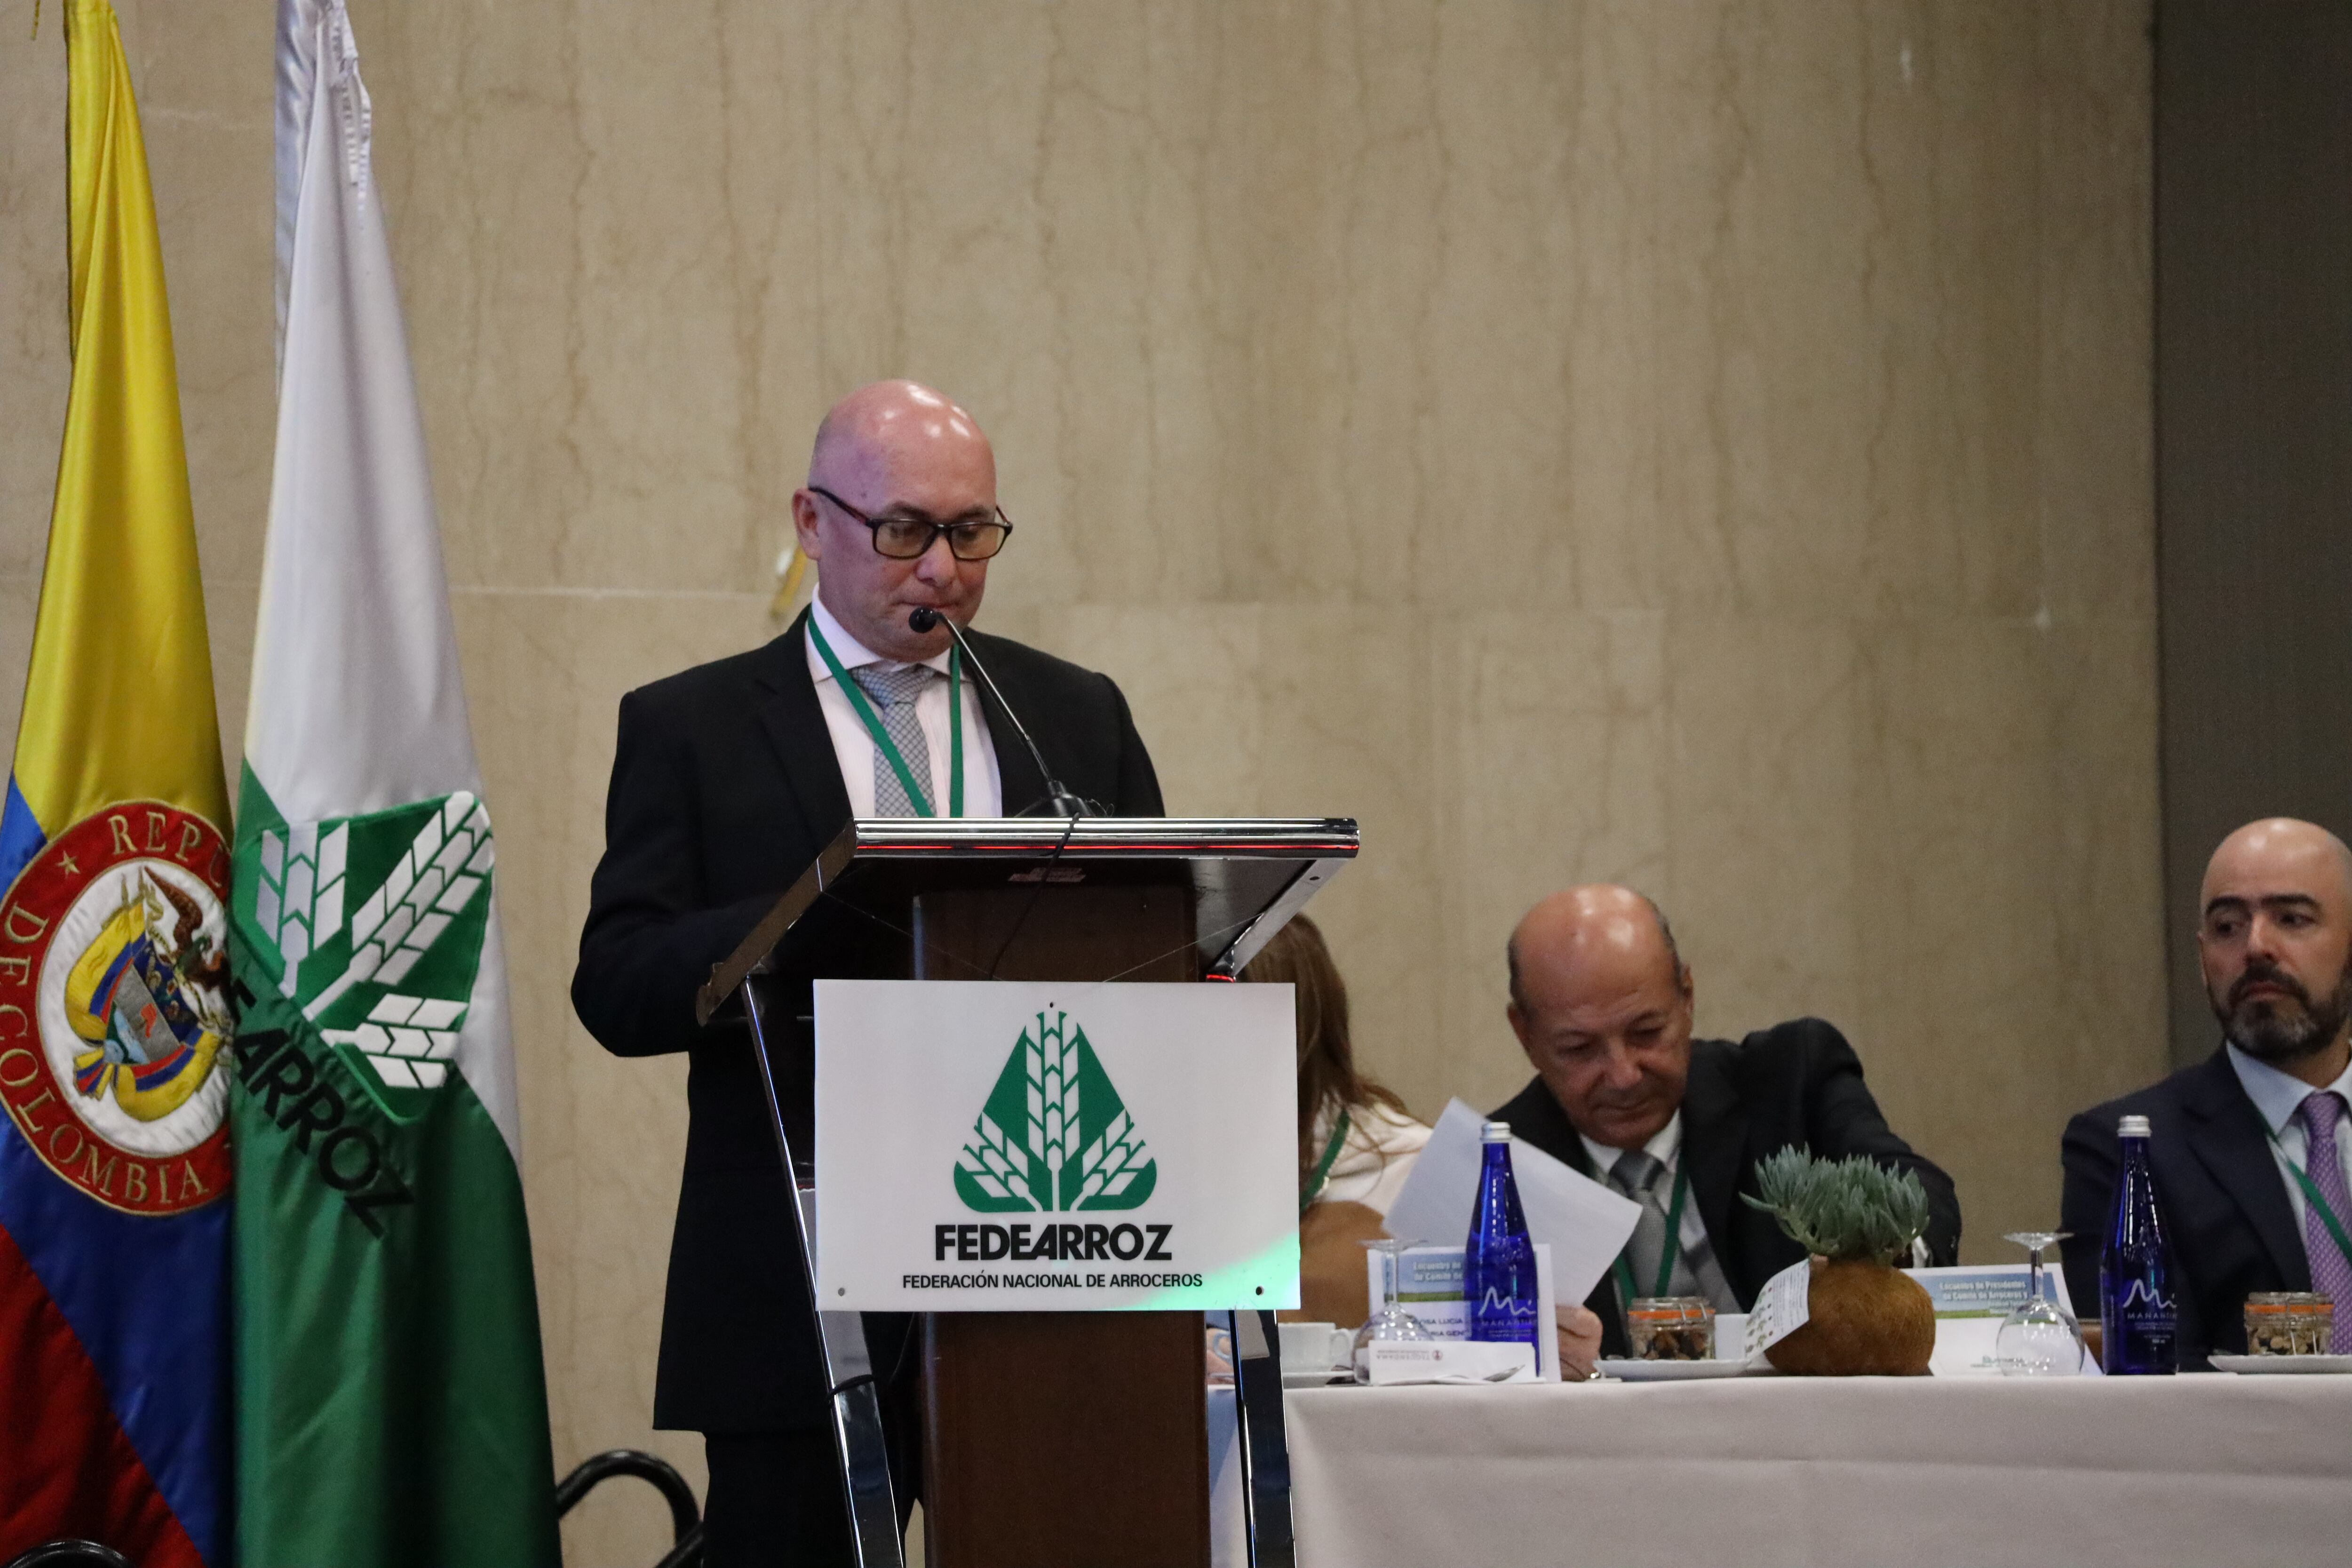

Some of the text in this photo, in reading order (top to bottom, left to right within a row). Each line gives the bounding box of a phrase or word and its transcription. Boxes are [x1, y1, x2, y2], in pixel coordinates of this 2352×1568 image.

[0, 1003, 210, 1204] COLOMBIA
[935, 1223, 1173, 1261] FEDEARROZ
[902, 1270, 1203, 1289] FEDERACIÓN NACIONAL DE ARROCEROS
